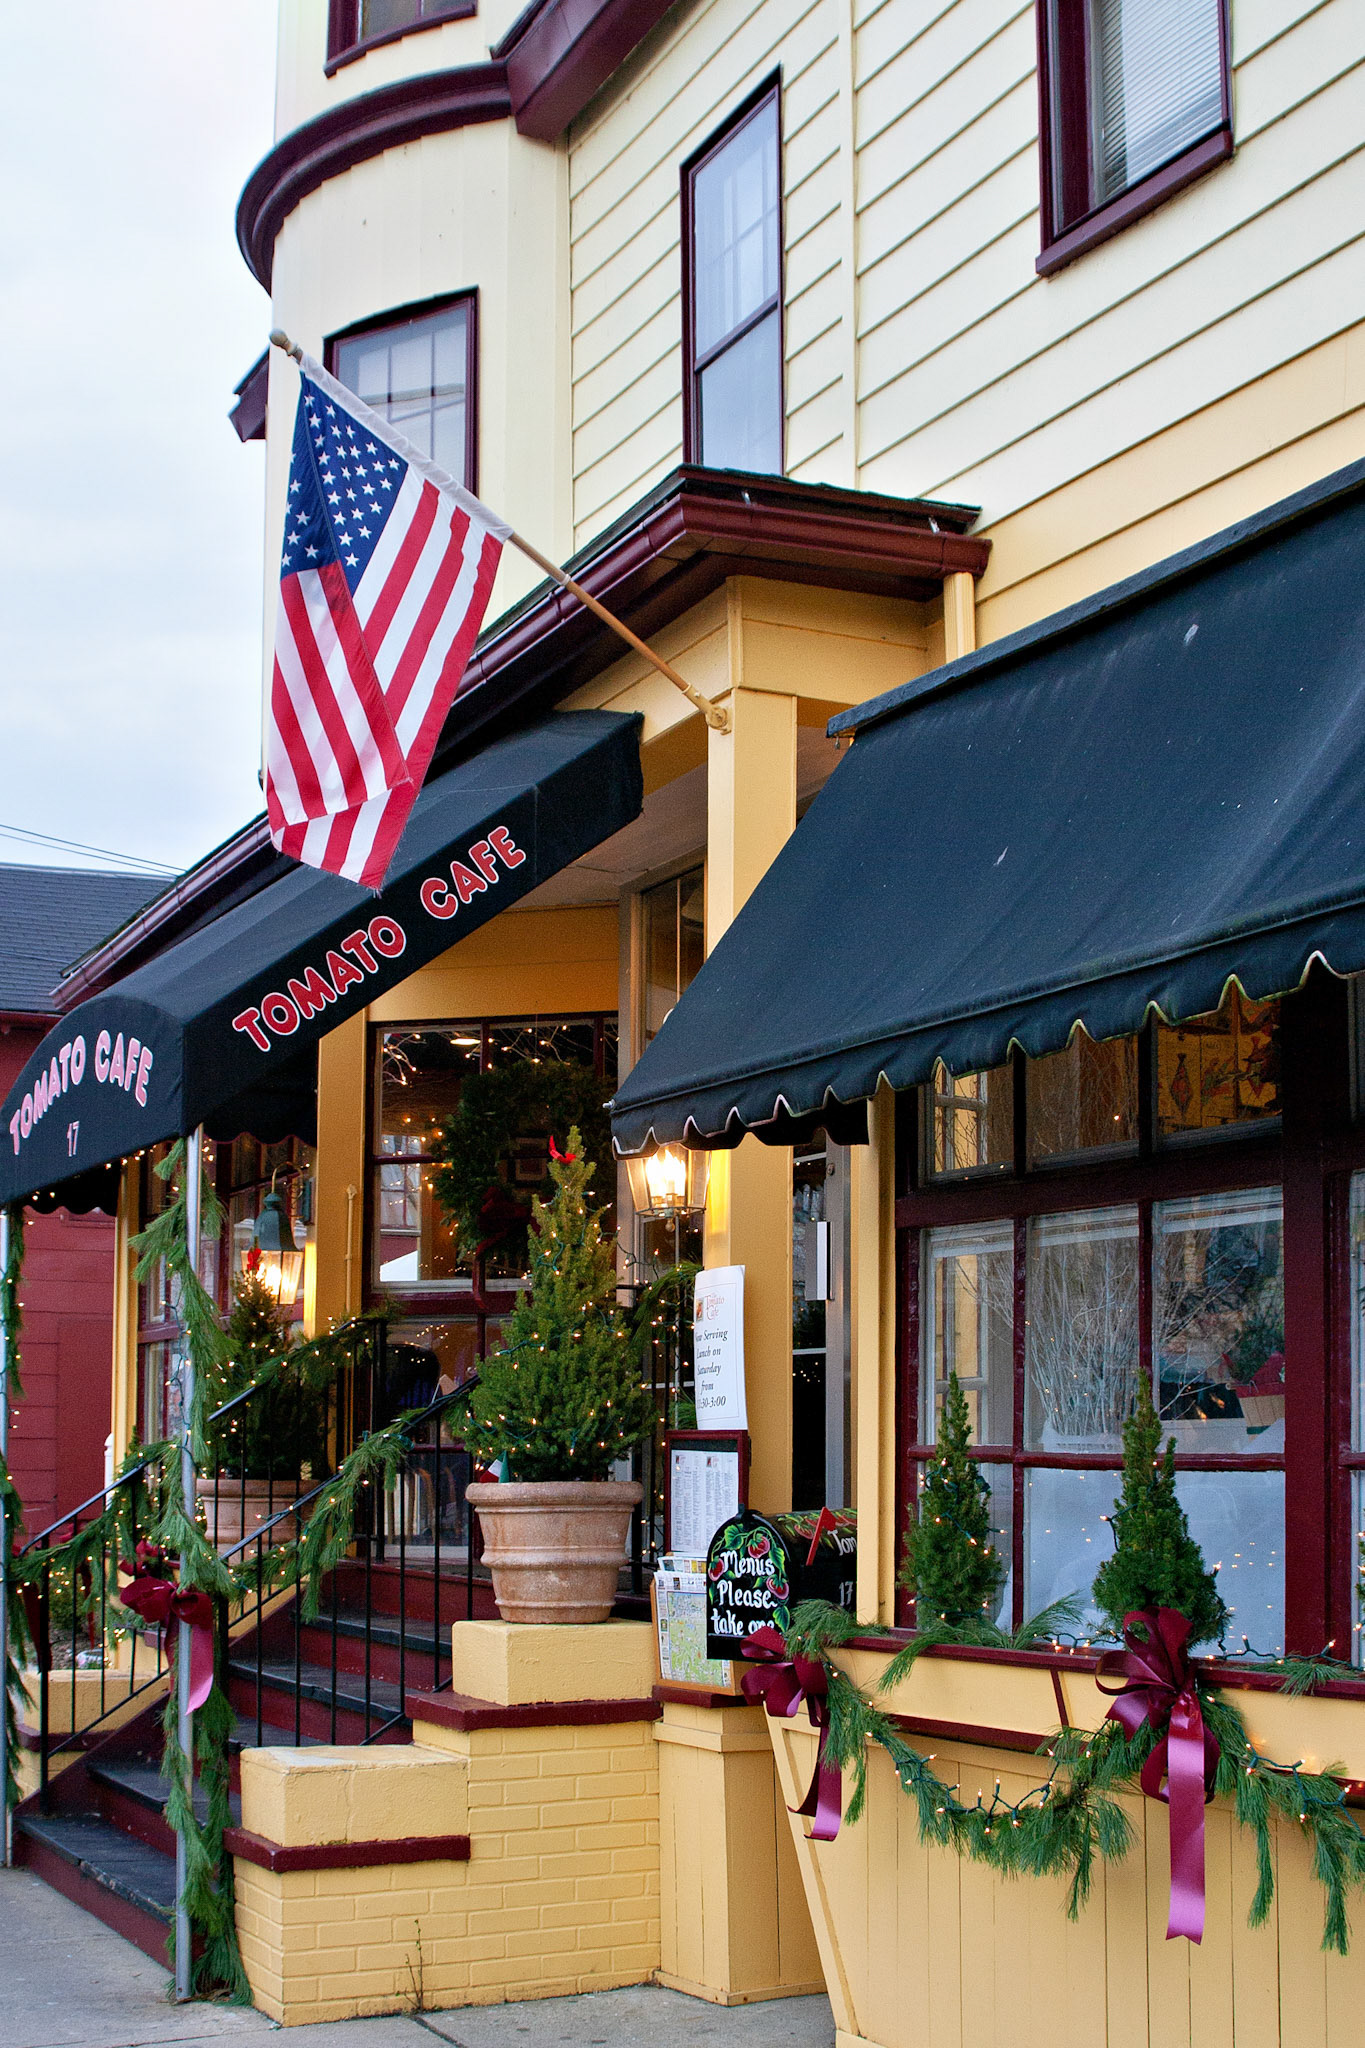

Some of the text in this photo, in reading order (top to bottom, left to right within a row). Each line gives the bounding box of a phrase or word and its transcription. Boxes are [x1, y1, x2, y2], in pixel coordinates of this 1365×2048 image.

[232, 825, 527, 1053] TOMATO CAFE
[9, 1029, 154, 1156] TOMATO CAFE
[65, 1120, 80, 1157] 17
[704, 1328, 728, 1342] Serving
[712, 1348, 721, 1356] on
[697, 1362, 721, 1376] Saturday
[700, 1380, 714, 1395] from
[720, 1550, 775, 1578] Menus
[717, 1580, 778, 1609] Please
[839, 1581, 853, 1607] 17
[711, 1608, 744, 1636] take
